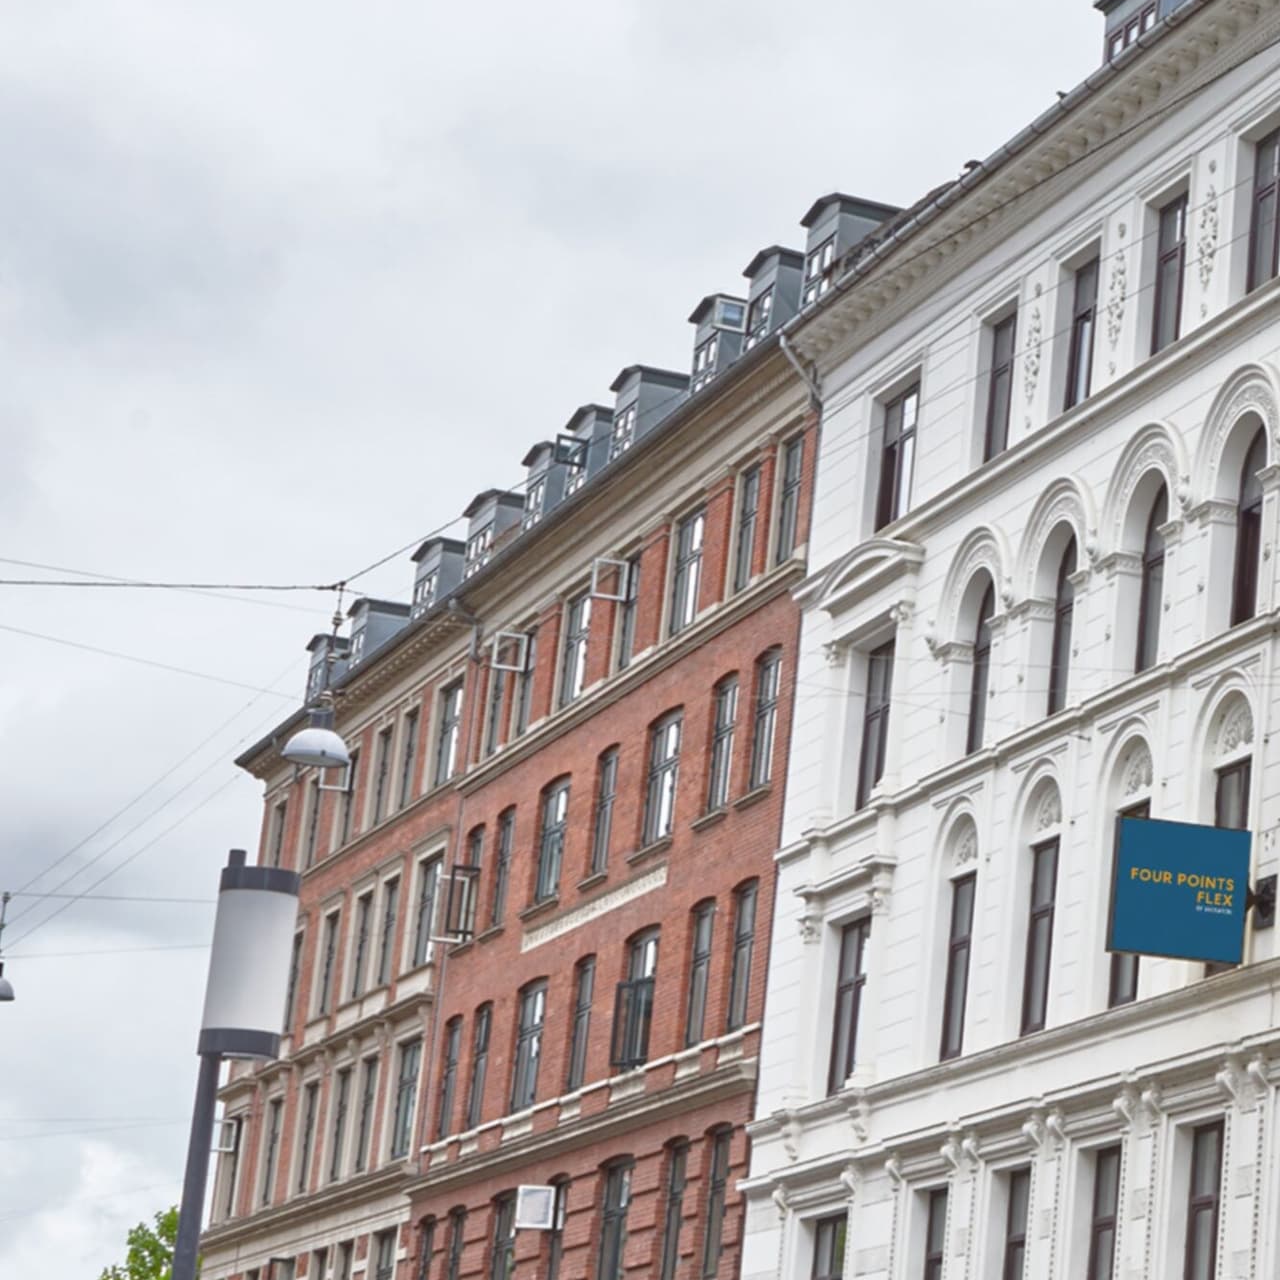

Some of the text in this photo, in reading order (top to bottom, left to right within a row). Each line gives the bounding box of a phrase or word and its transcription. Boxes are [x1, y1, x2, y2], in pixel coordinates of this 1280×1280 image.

[1130, 867, 1235, 892] FOUR POINTS
[1196, 890, 1233, 907] FLEX
